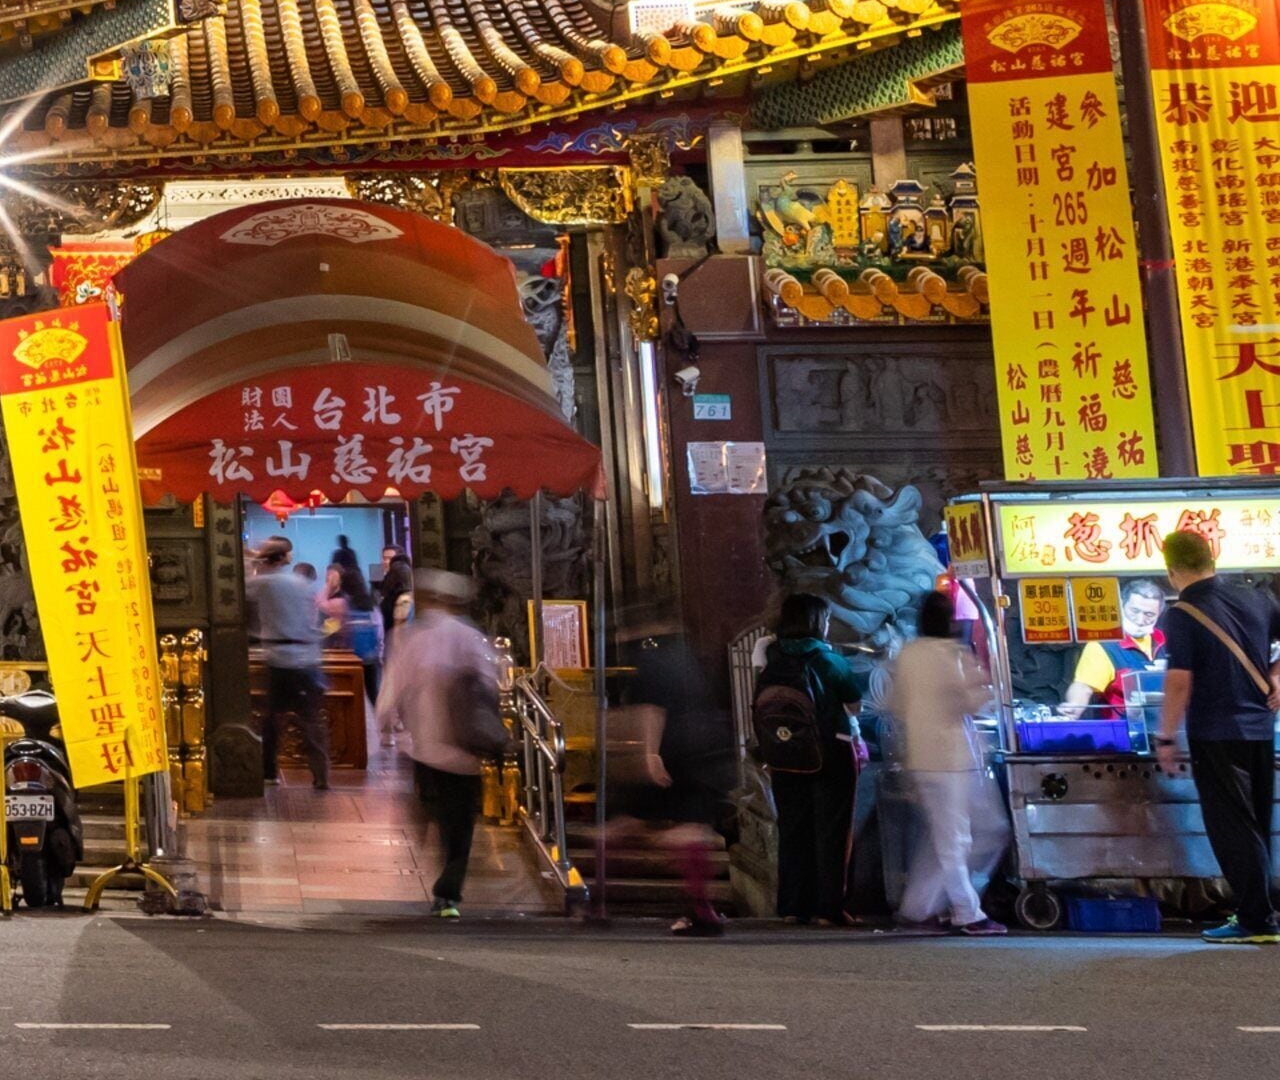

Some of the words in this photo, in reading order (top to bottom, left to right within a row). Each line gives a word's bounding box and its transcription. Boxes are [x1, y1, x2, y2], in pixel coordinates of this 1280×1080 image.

[990, 52, 1085, 73] 松山慈祐宮
[1160, 81, 1280, 126] 恭迎
[241, 387, 293, 408] 財團
[313, 382, 461, 431] 台北市
[696, 405, 727, 417] 761
[244, 412, 298, 432] 法人
[208, 435, 494, 484] 松山慈祐宮
